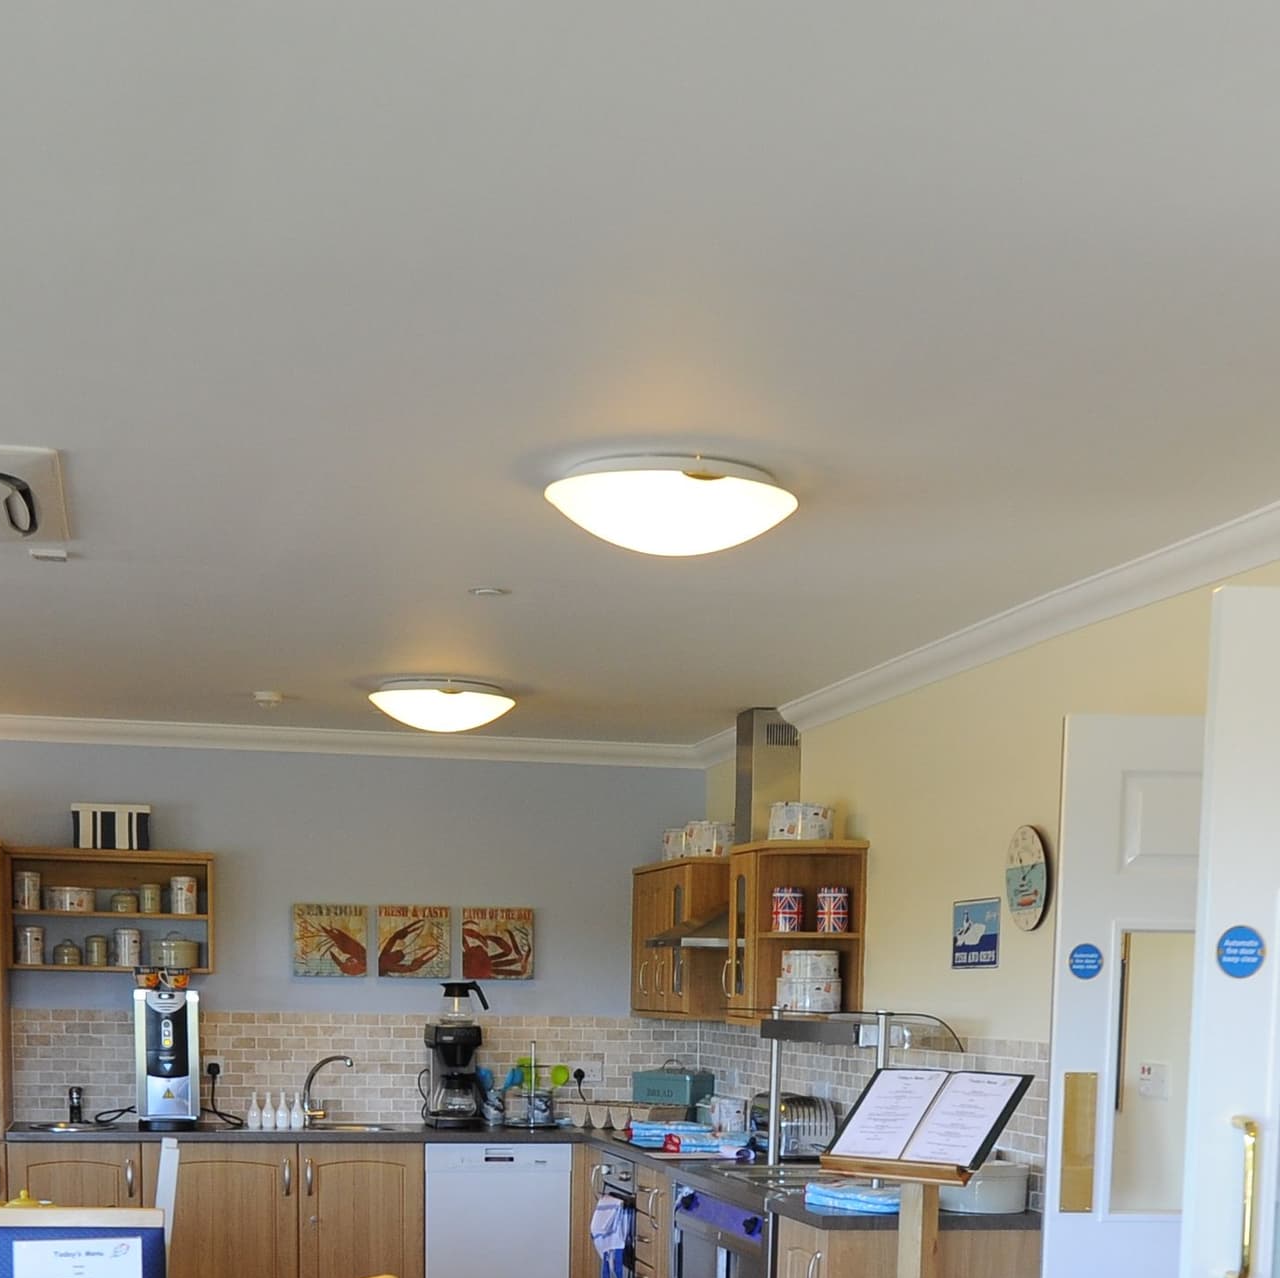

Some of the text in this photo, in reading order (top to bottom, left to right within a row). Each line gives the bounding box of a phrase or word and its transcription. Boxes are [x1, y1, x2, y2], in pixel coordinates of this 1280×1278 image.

[296, 904, 363, 917] SEAFOOD
[378, 905, 409, 917] FRESH
[422, 906, 449, 919] TASTY
[463, 908, 487, 920] CATCH
[646, 1088, 673, 1097] BREAD
